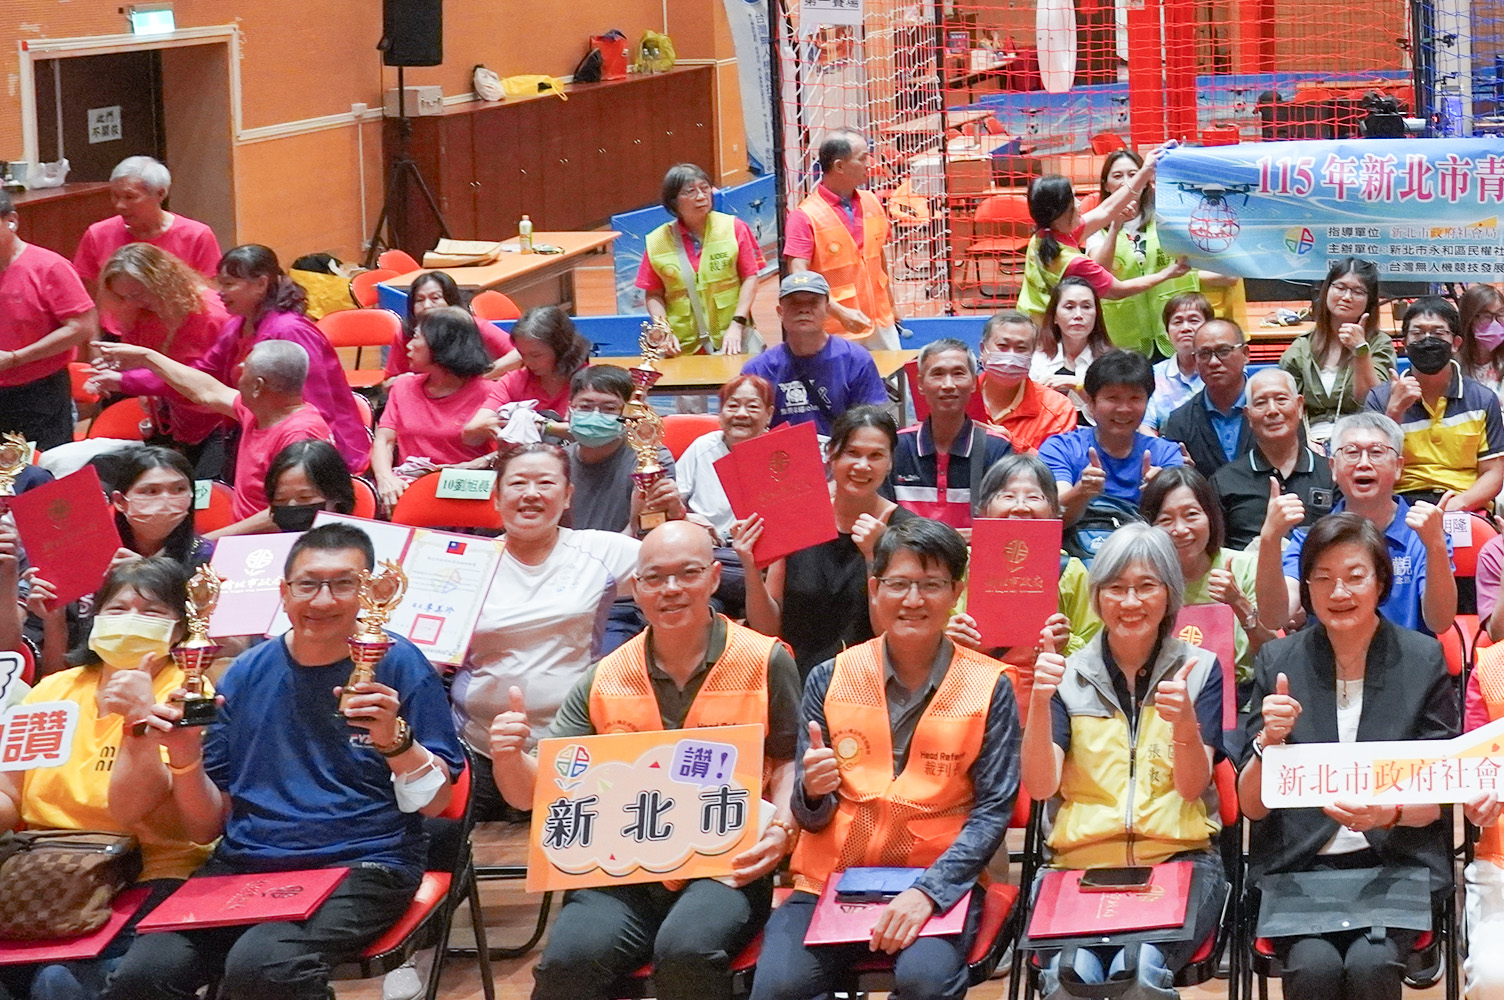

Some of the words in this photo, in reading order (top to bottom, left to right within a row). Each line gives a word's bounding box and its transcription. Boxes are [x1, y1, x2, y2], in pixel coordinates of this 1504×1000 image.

[1327, 226, 1380, 238] 指導單位
[0, 710, 68, 763] 讚
[920, 750, 937, 762] Head
[543, 786, 749, 849] 新北市
